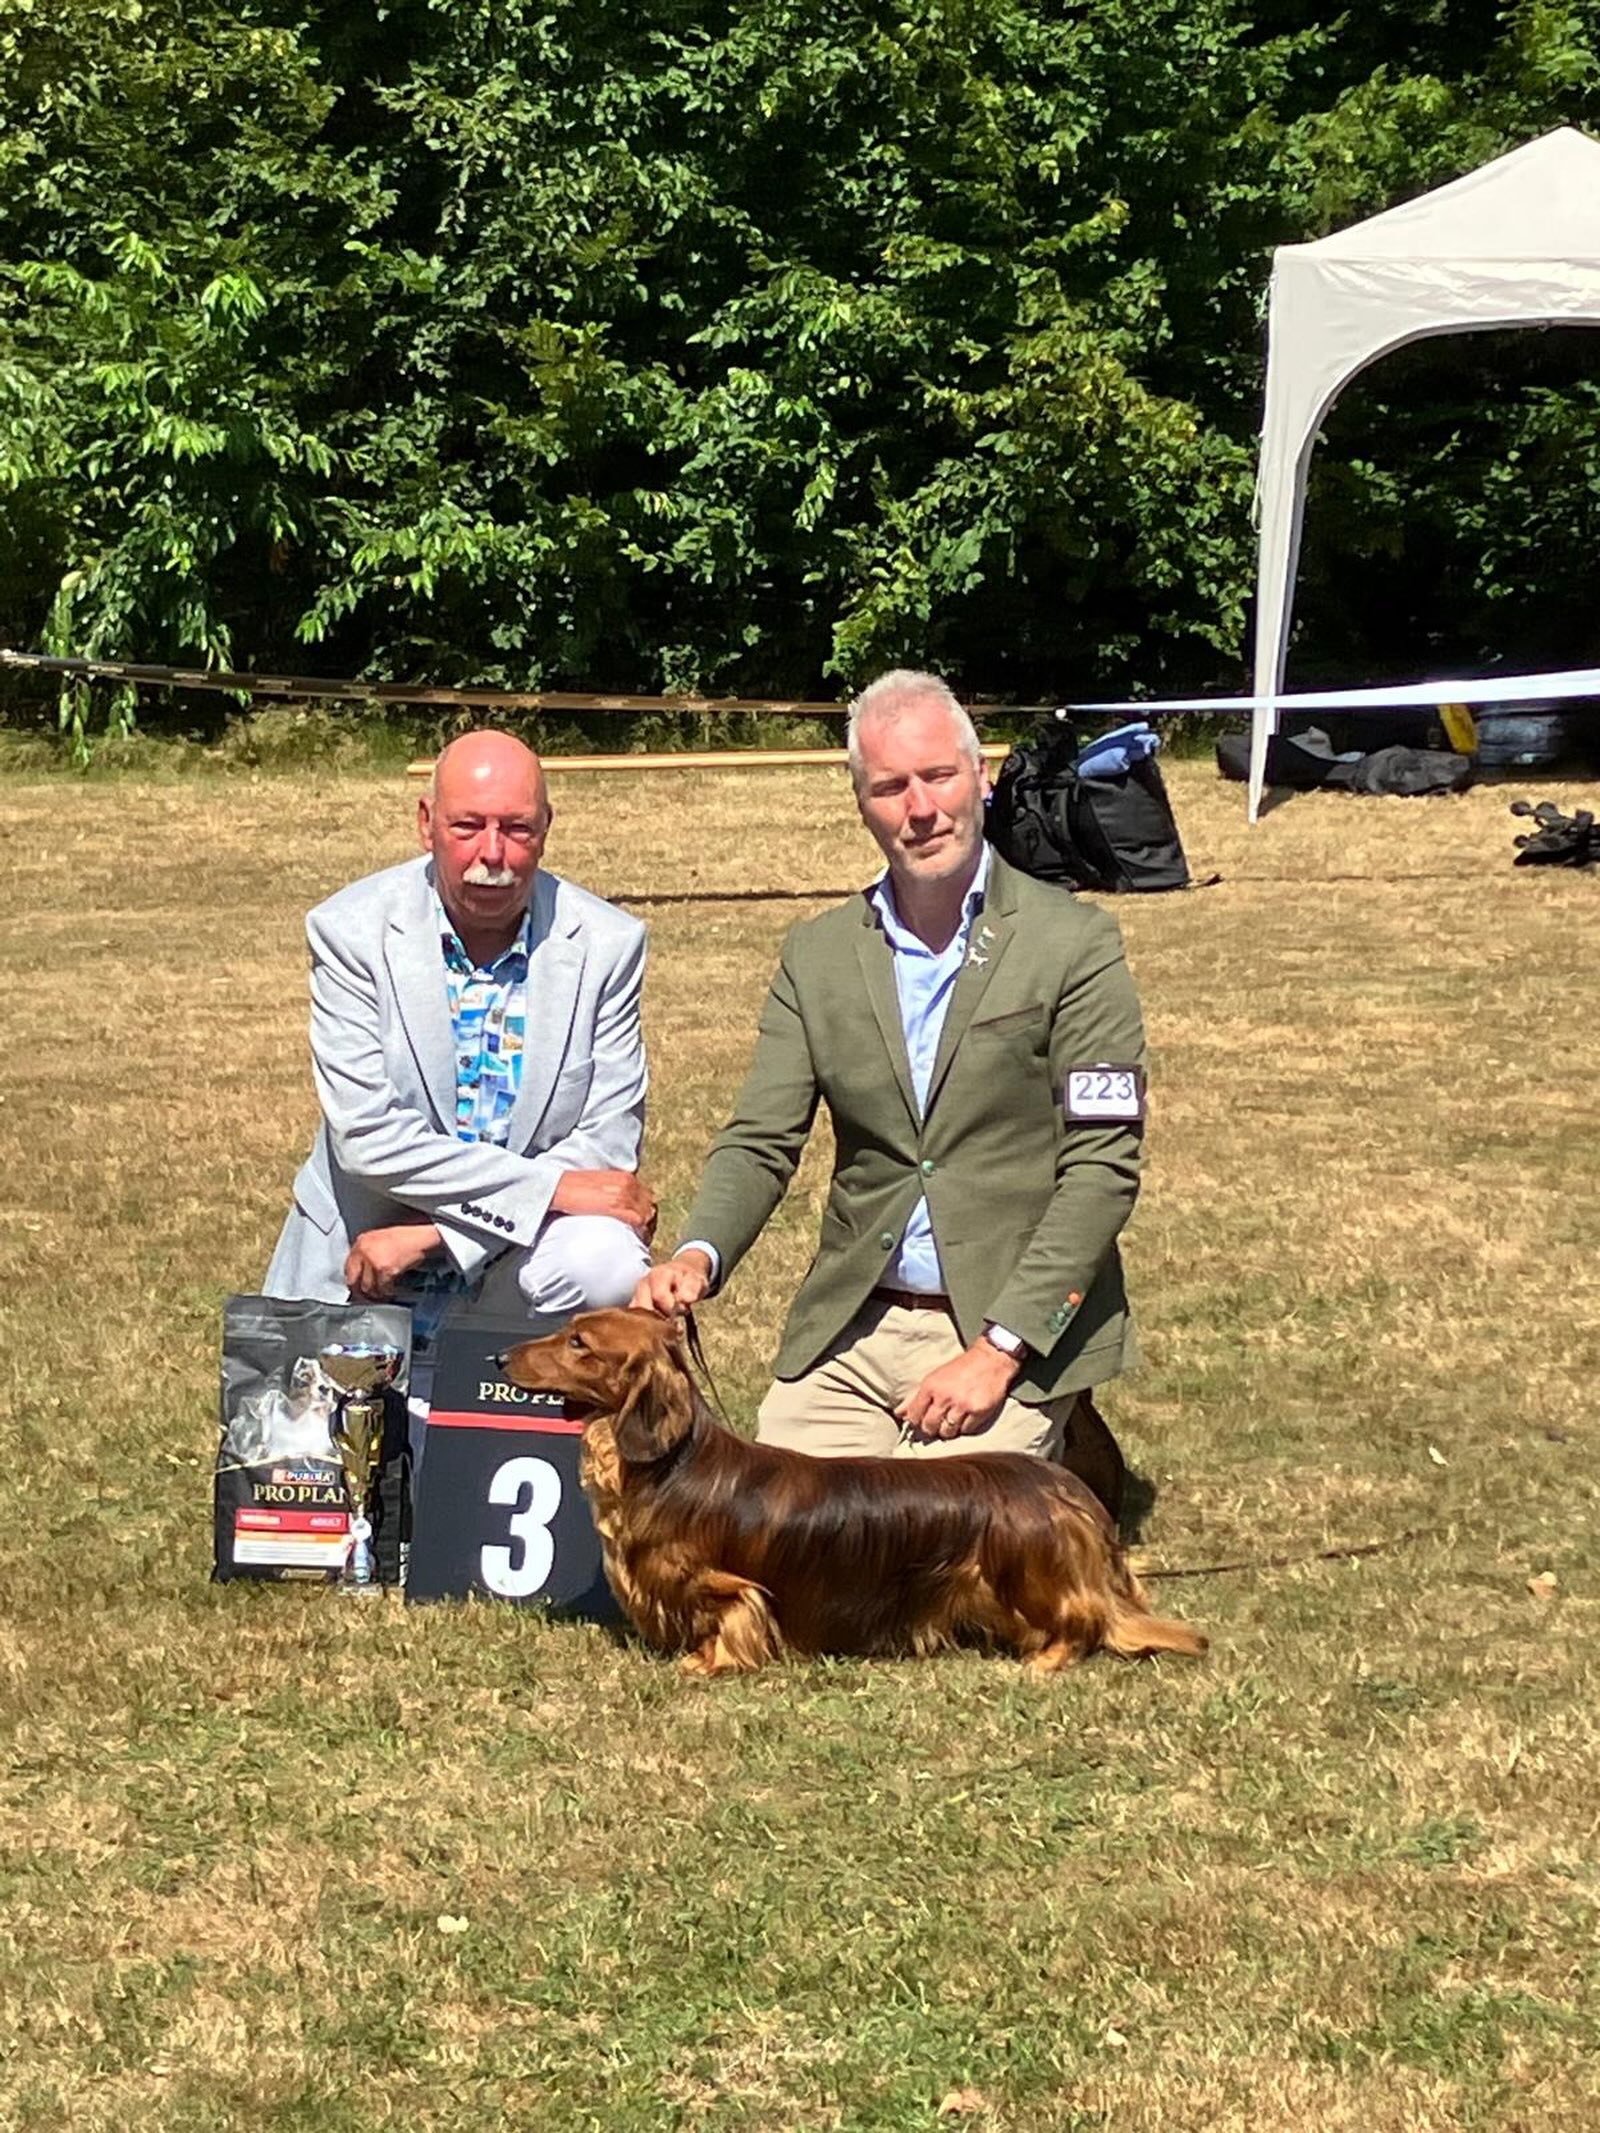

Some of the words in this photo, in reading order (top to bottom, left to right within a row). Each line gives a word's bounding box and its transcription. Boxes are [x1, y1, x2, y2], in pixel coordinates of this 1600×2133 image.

[1075, 1073, 1133, 1101] 223
[477, 1381, 528, 1403] PRO
[253, 1483, 295, 1502] PRO
[481, 1456, 562, 1597] 3
